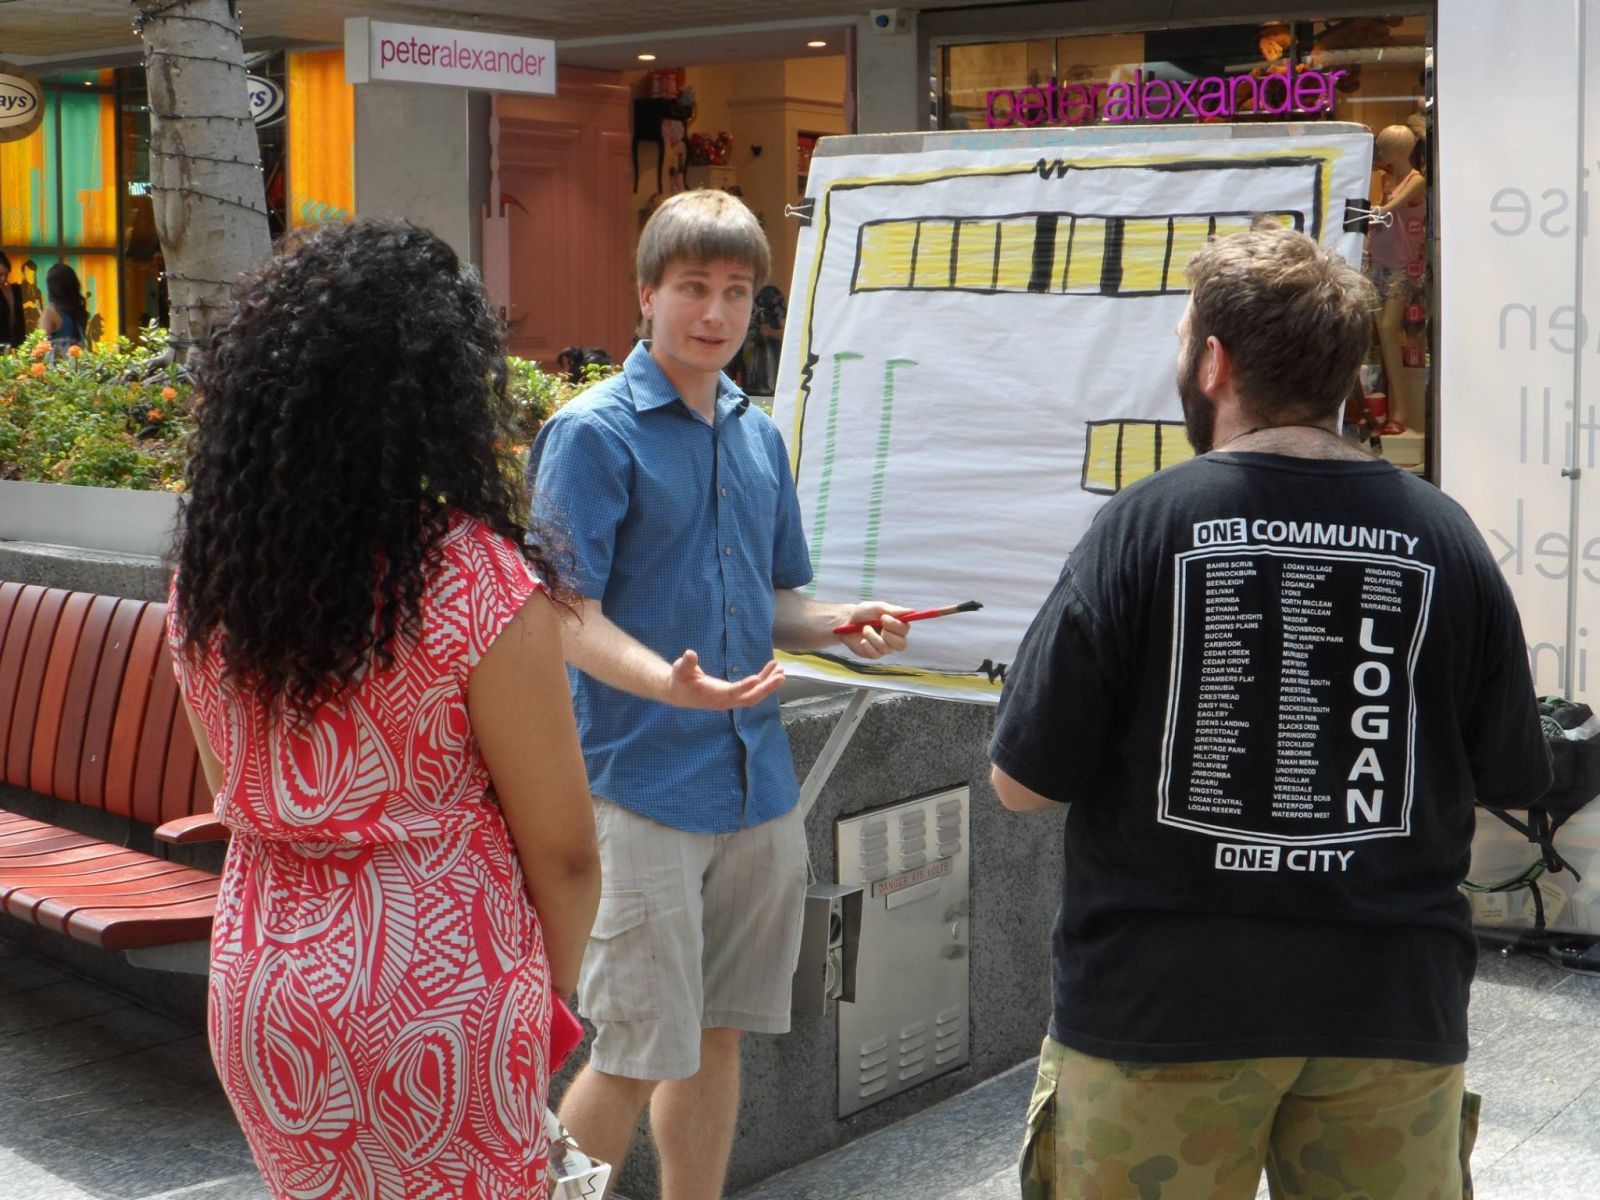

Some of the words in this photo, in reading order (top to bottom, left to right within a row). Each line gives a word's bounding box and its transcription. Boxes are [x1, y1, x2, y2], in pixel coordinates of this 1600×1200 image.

[381, 36, 546, 76] peteralexander
[986, 58, 1346, 128] peteralexander
[1198, 522, 1243, 545] ONE
[1252, 519, 1419, 555] COMMUNITY
[1347, 618, 1394, 824] LOGAN
[1220, 848, 1278, 868] ONE
[1286, 849, 1355, 872] CITY
[879, 873, 909, 893] DANGER
